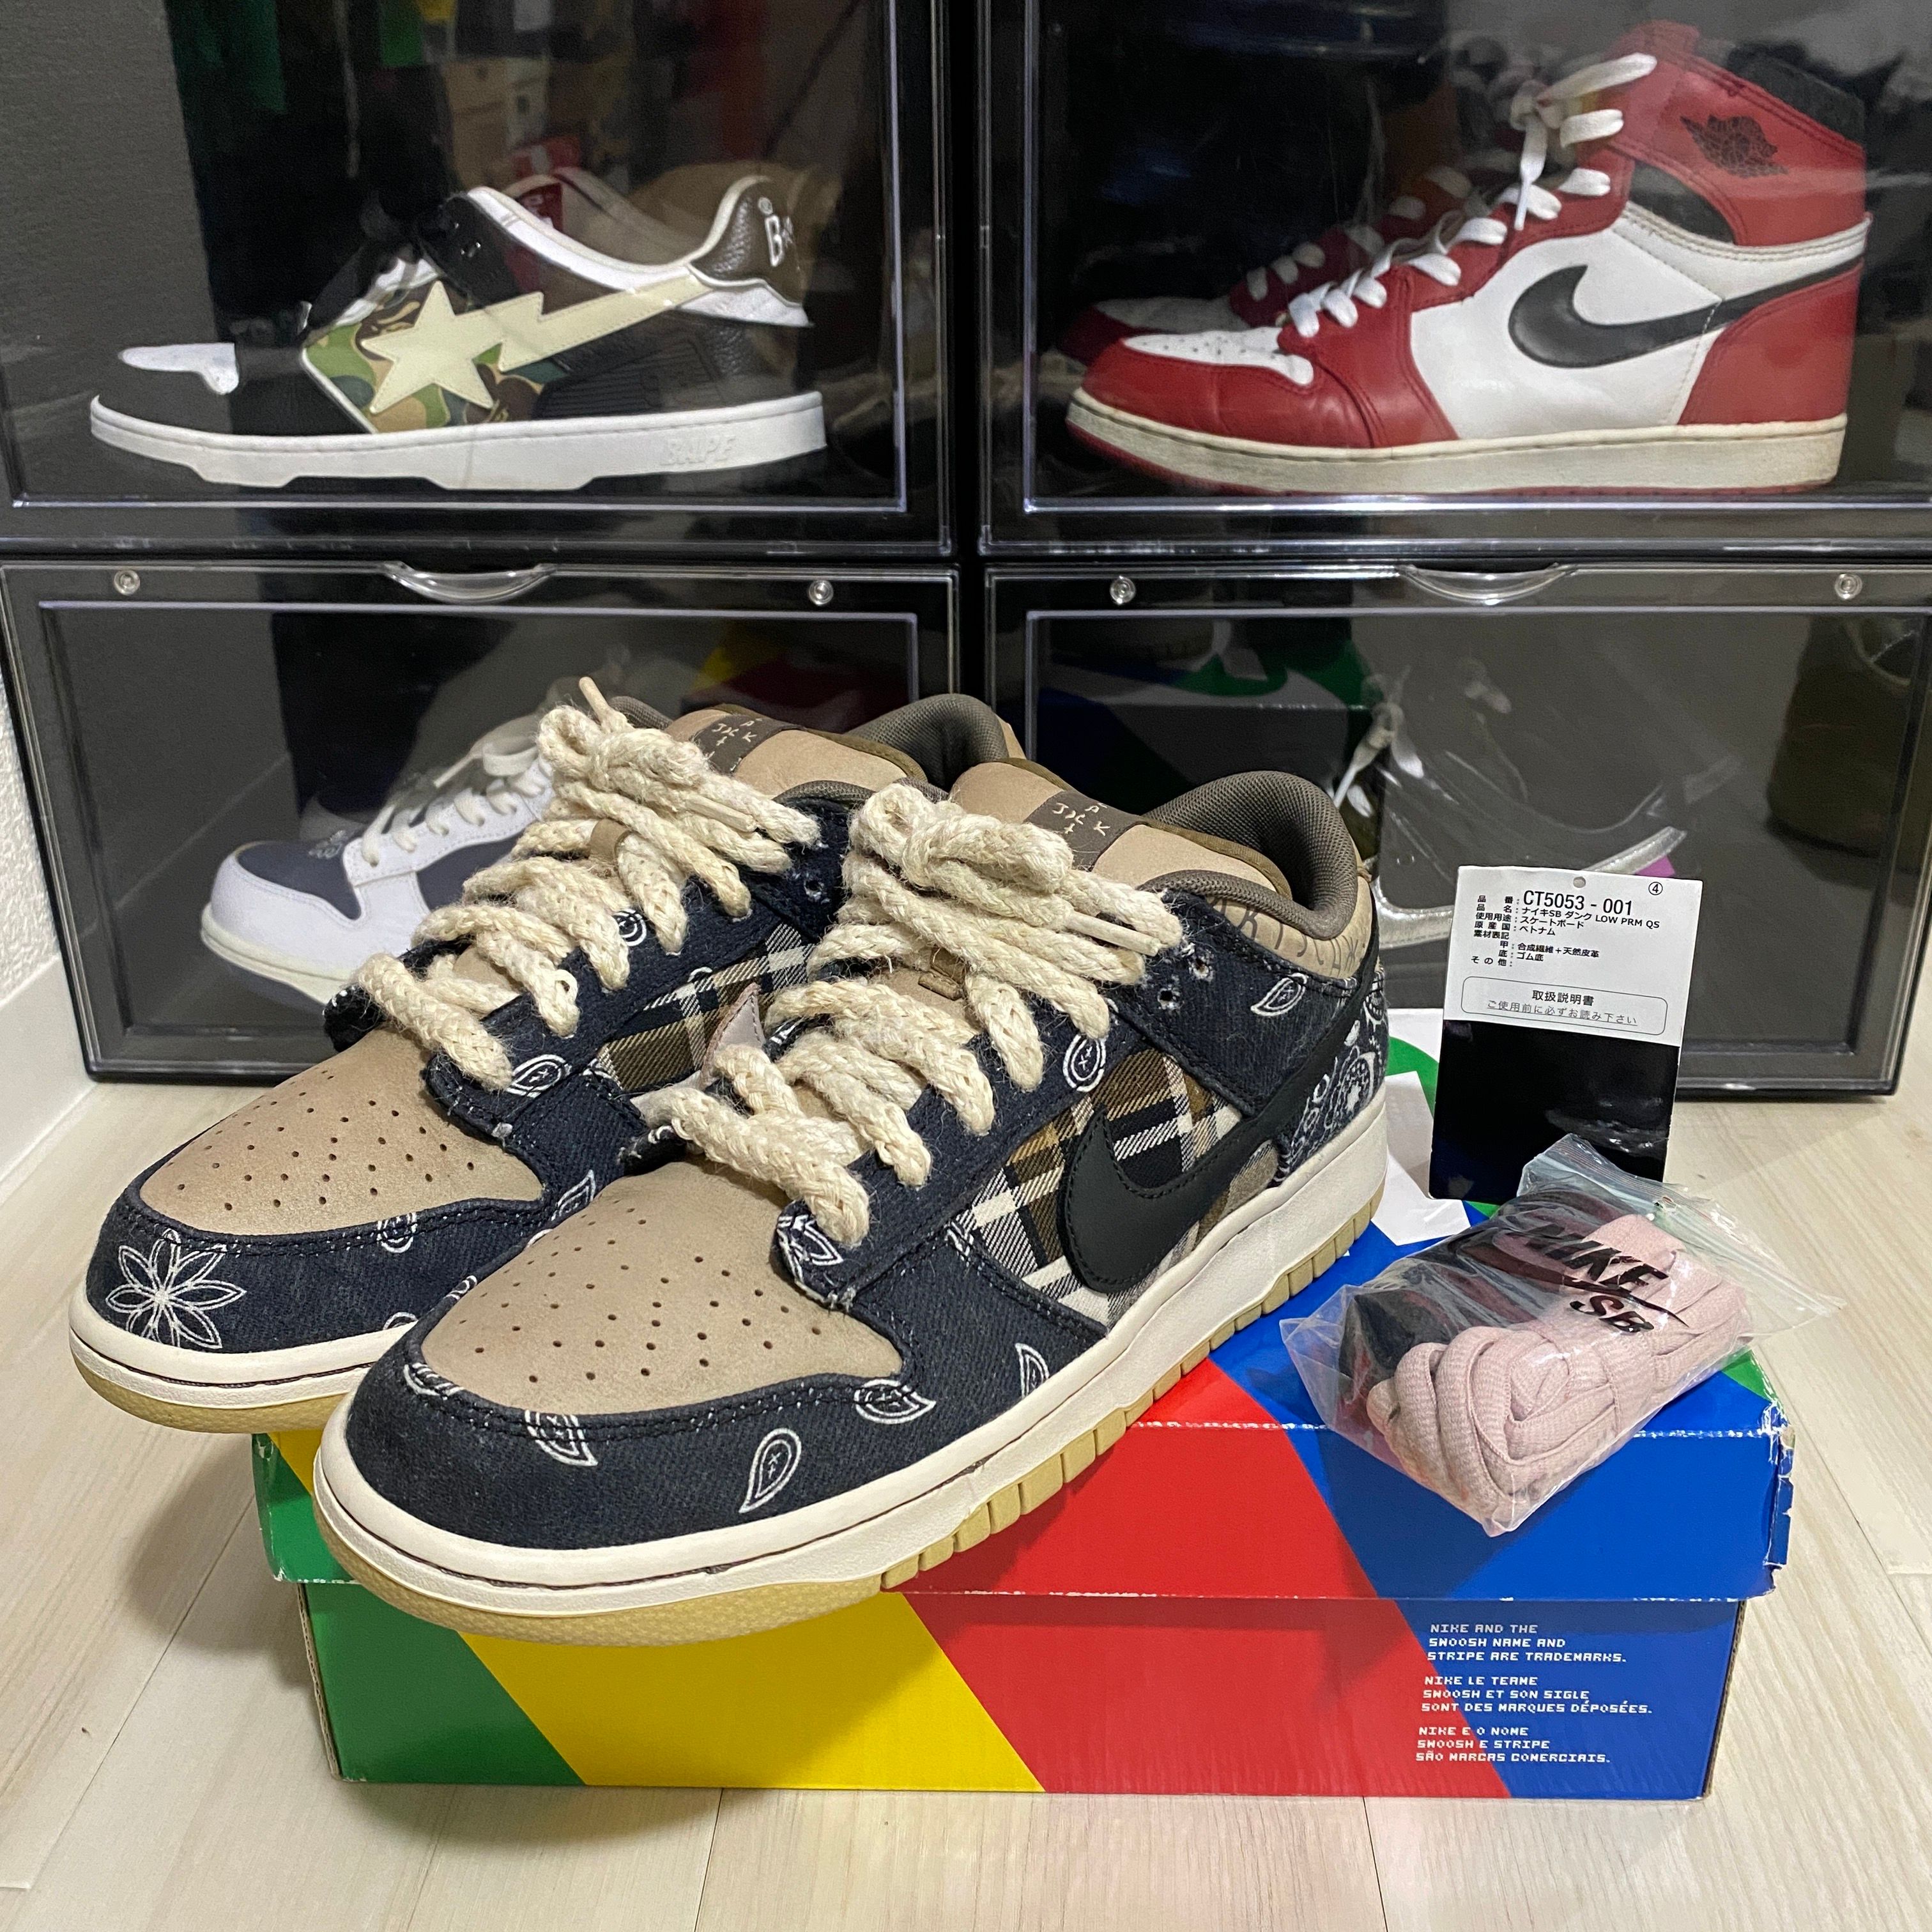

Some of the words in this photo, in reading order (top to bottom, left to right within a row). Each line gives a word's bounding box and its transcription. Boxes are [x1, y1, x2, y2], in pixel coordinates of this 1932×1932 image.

[1523, 890, 1585, 910] CT5053
[1603, 898, 1632, 916] 001
[1520, 916, 1584, 929] スケートボード
[1565, 911, 1592, 921] ダンク
[1595, 915, 1618, 924] LOW
[1621, 917, 1643, 926] PRM
[1646, 921, 1660, 929] QS
[1519, 926, 1555, 935] ベトナム
[1531, 990, 1594, 1006] 取扱説明書
[1430, 1624, 1469, 1633] NIKE
[1475, 1624, 1503, 1633] AND
[1510, 1624, 1538, 1634] THE
[1429, 1637, 1487, 1647] SWOOSH
[1492, 1637, 1532, 1648] NAME
[1537, 1638, 1566, 1648] AND
[1427, 1651, 1485, 1661] STRIPE
[1490, 1652, 1519, 1661] ARE
[1525, 1652, 1627, 1662] TRADEMARKS.
[1424, 1676, 1463, 1685] NIKE
[1468, 1676, 1485, 1685] LE
[1423, 1689, 1480, 1699] SWOOSH
[1485, 1689, 1505, 1699] ET
[1510, 1690, 1538, 1699] SON
[1543, 1690, 1590, 1699] SIGLE
[1421, 1703, 1459, 1712] SONT
[1464, 1703, 1493, 1712] DES
[1498, 1703, 1565, 1713] MARQUES
[1570, 1700, 1652, 1713] DÉPOSÉES.
[1418, 1726, 1457, 1736] NIKE
[1462, 1726, 1471, 1736] E
[1476, 1726, 1485, 1736] O
[1491, 1727, 1529, 1736] NOME
[1417, 1740, 1474, 1749] SWOOSH
[1479, 1740, 1489, 1749] E
[1493, 1740, 1551, 1749] STRIPE
[1415, 1750, 1444, 1761] SÃO
[1449, 1752, 1506, 1762] MARCAS
[1510, 1752, 1611, 1763] COMERCIAIS.
